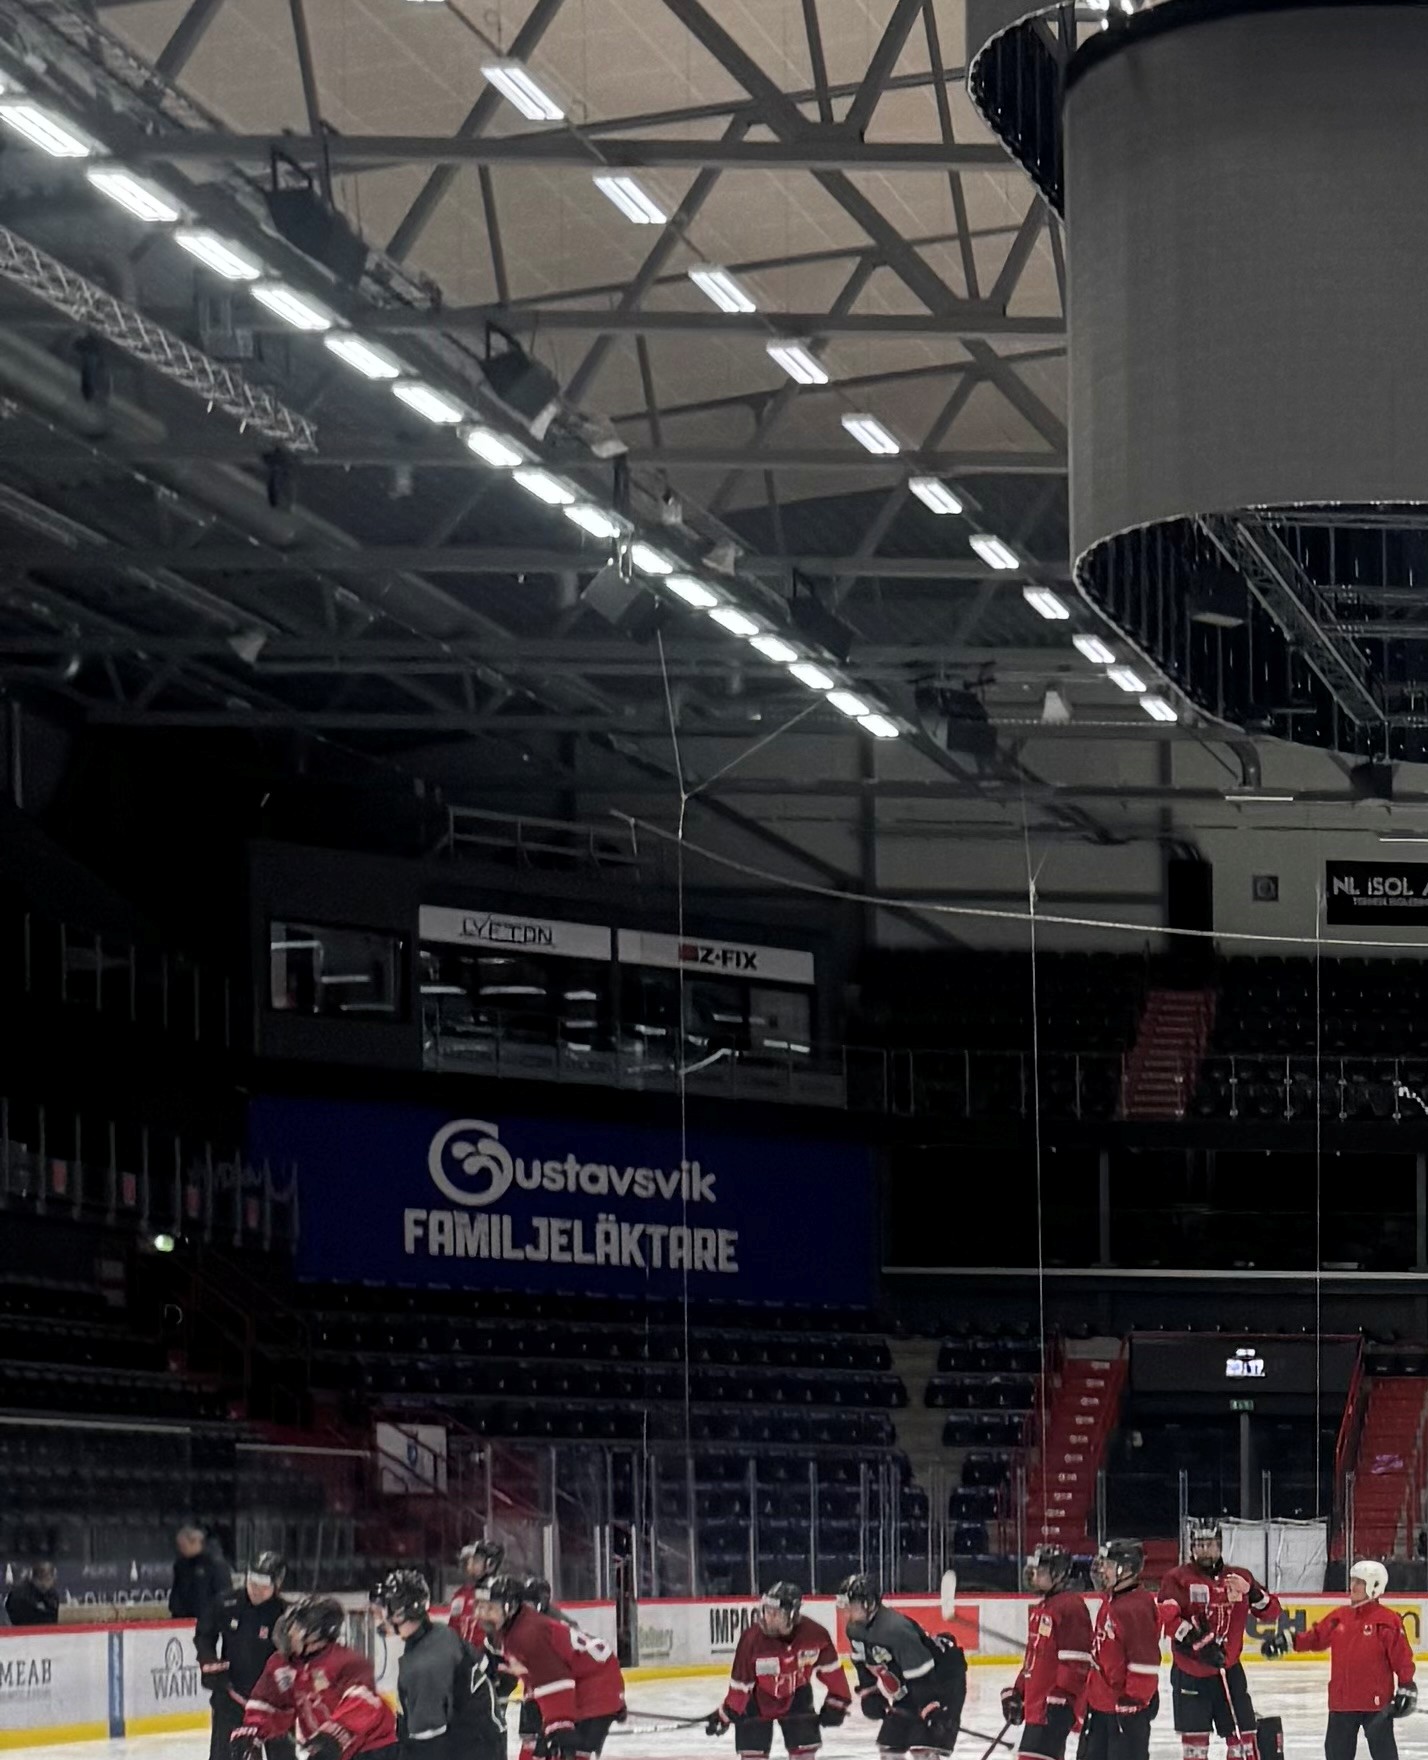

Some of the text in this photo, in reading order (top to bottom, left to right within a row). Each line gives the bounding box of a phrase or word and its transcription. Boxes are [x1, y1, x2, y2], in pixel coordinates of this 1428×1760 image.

[1332, 875, 1361, 897] NL
[403, 1201, 740, 1274] FAMILJELÄKTARE
[153, 1669, 199, 1701] WANI
